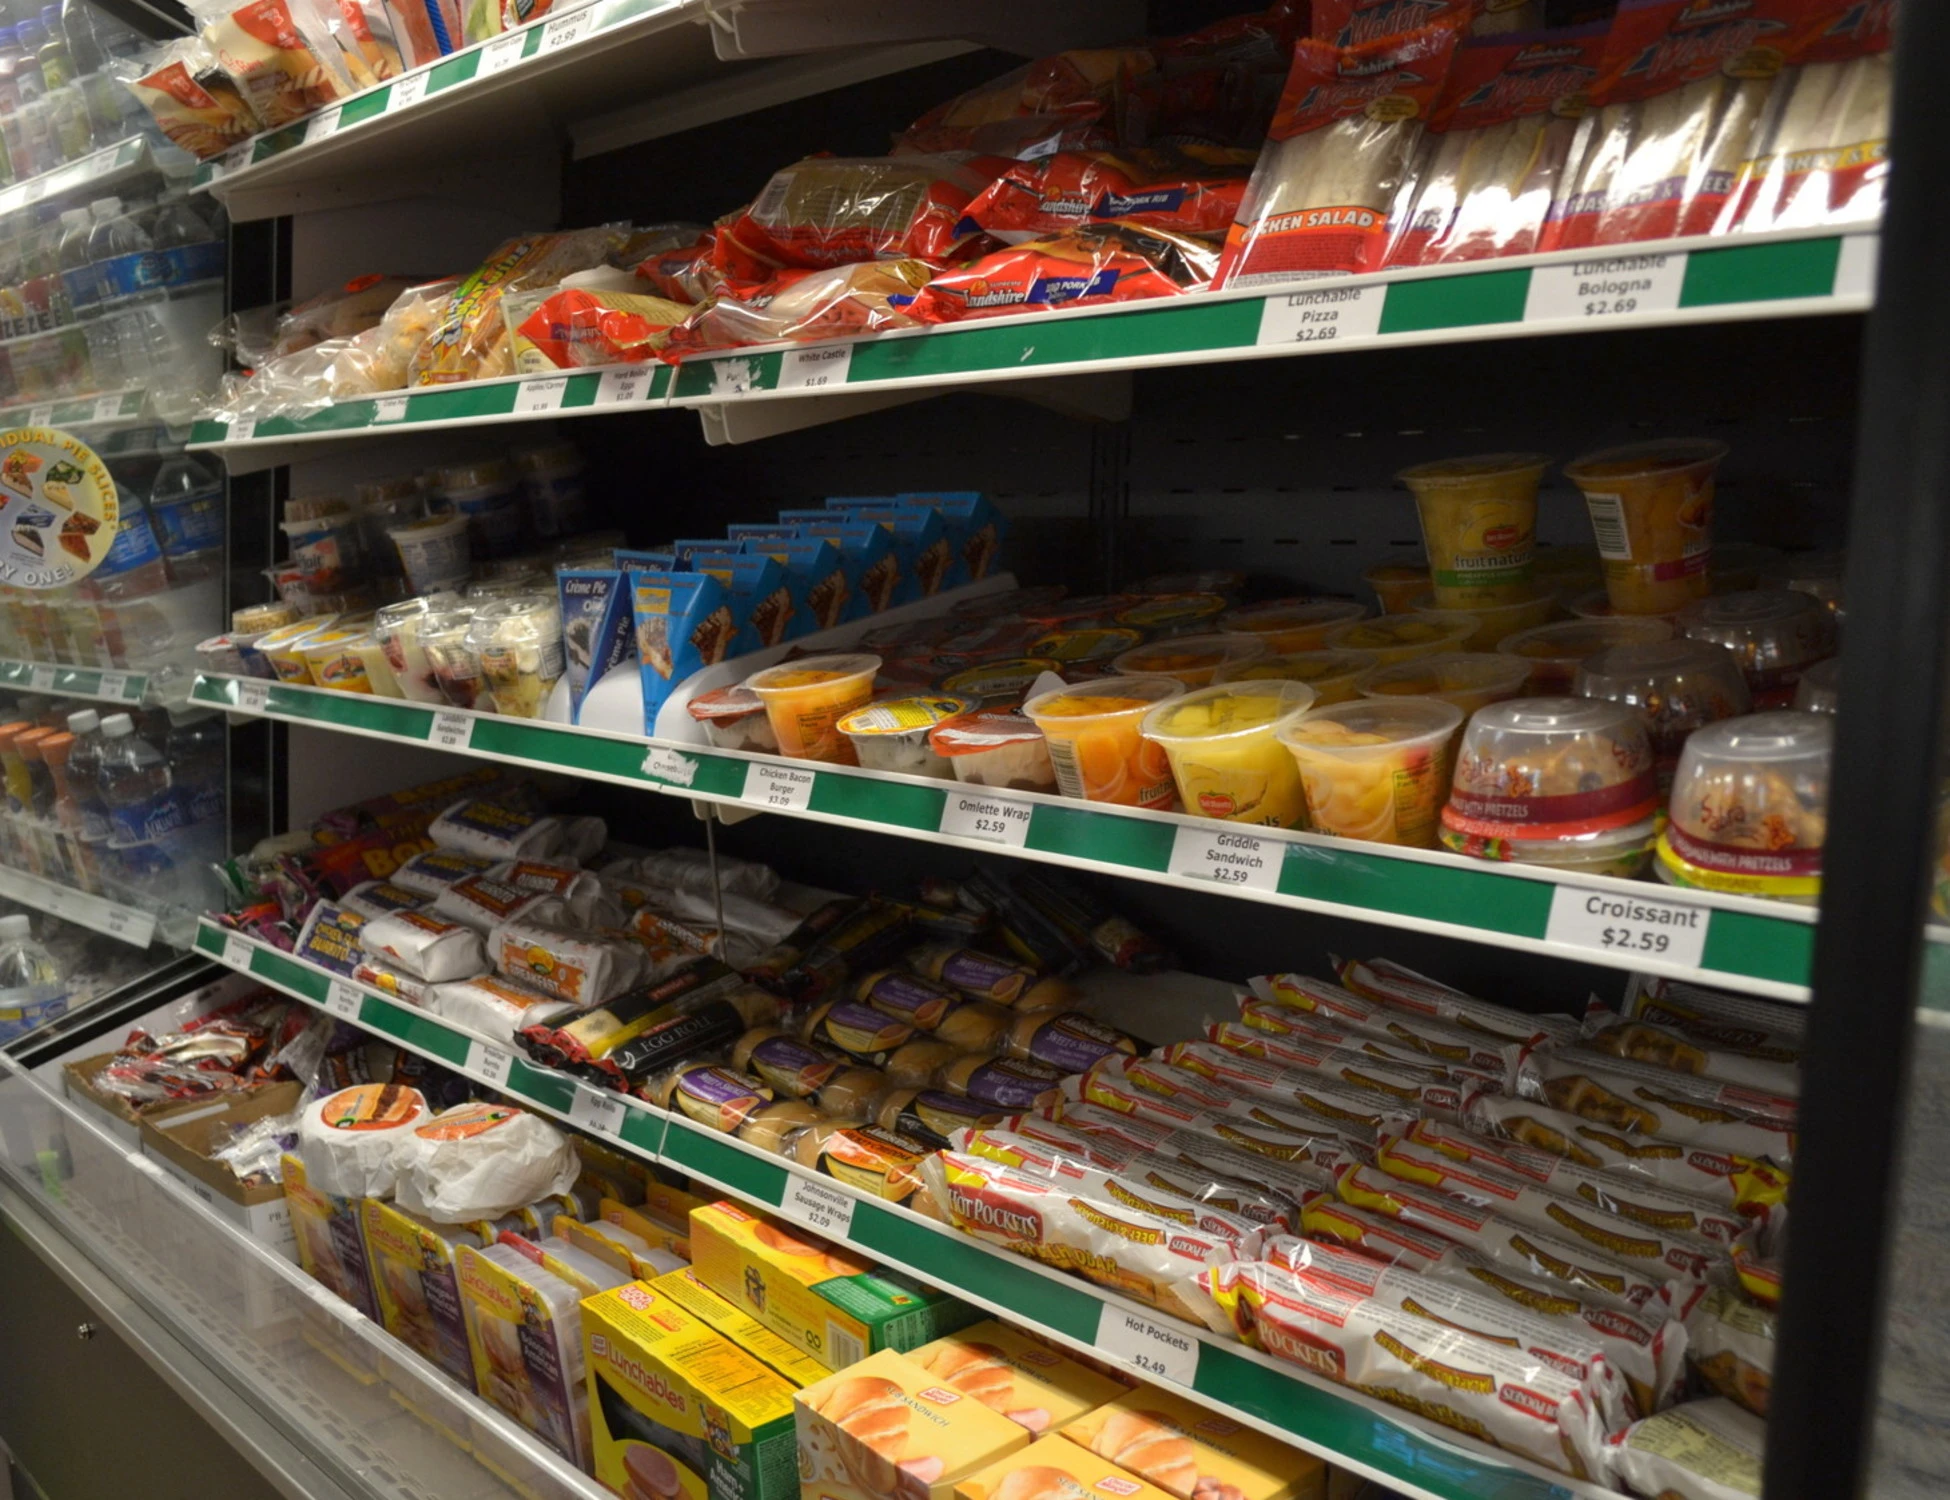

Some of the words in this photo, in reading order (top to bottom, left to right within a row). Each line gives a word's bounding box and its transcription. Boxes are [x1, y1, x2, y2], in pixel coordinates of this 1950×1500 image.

[547, 10, 589, 34] Hummus
[550, 28, 577, 47] $2.99
[1241, 212, 1303, 242] CCKEN
[1307, 209, 1374, 229] SALAD
[1573, 254, 1667, 277] Lunchable
[1060, 279, 1086, 292] PORK
[1577, 276, 1652, 297] Bologna
[964, 289, 1025, 309] Landshire
[1287, 286, 1362, 308] Lunchable
[1584, 297, 1637, 317] $2.69
[1301, 309, 1339, 325] Pizza
[1295, 325, 1337, 343] $2.69
[798, 350, 821, 364] White
[821, 348, 847, 361] Castle
[805, 375, 828, 388] $1.69
[63, 440, 90, 462] PIE
[24, 562, 75, 586] ONE!
[565, 579, 591, 595] Crème
[592, 580, 608, 595] Pie
[760, 766, 788, 783] Chicken
[789, 771, 812, 785] Bacon
[770, 781, 795, 796] Burger
[958, 798, 1000, 817] Omlette
[1002, 804, 1031, 823] Wrap
[1484, 804, 1529, 818] PRETZELS
[974, 818, 1006, 834] $2.59
[1216, 833, 1260, 852] Griddle
[1205, 848, 1264, 870] Sandwich
[1737, 855, 1793, 871] PRETZELS
[1212, 866, 1249, 884] $2.59
[1585, 896, 1700, 929] Croissant
[1601, 926, 1670, 953] $2.59
[640, 1028, 675, 1053] EGG
[675, 1015, 712, 1041] ROLL
[802, 1180, 849, 1209] Johnsonville
[794, 1191, 827, 1214] Sausage
[826, 1205, 851, 1224] Wraps
[949, 1187, 975, 1223] HOT
[975, 1199, 1039, 1239] POCKETS
[808, 1211, 831, 1228] $2.09
[1074, 1204, 1120, 1236] CHEDDAR
[1129, 1226, 1157, 1245] BEEF
[1047, 1241, 1118, 1274] CHDDAR
[1125, 1316, 1145, 1334] Hot
[1146, 1325, 1190, 1352] Pockets
[1258, 1325, 1338, 1374] POCKETS
[1135, 1353, 1166, 1375] $2.49
[607, 1341, 687, 1413] Lunchables
[886, 1385, 903, 1400] SUB
[901, 1395, 950, 1428] SANDWICH
[1057, 1475, 1078, 1493] SUB
